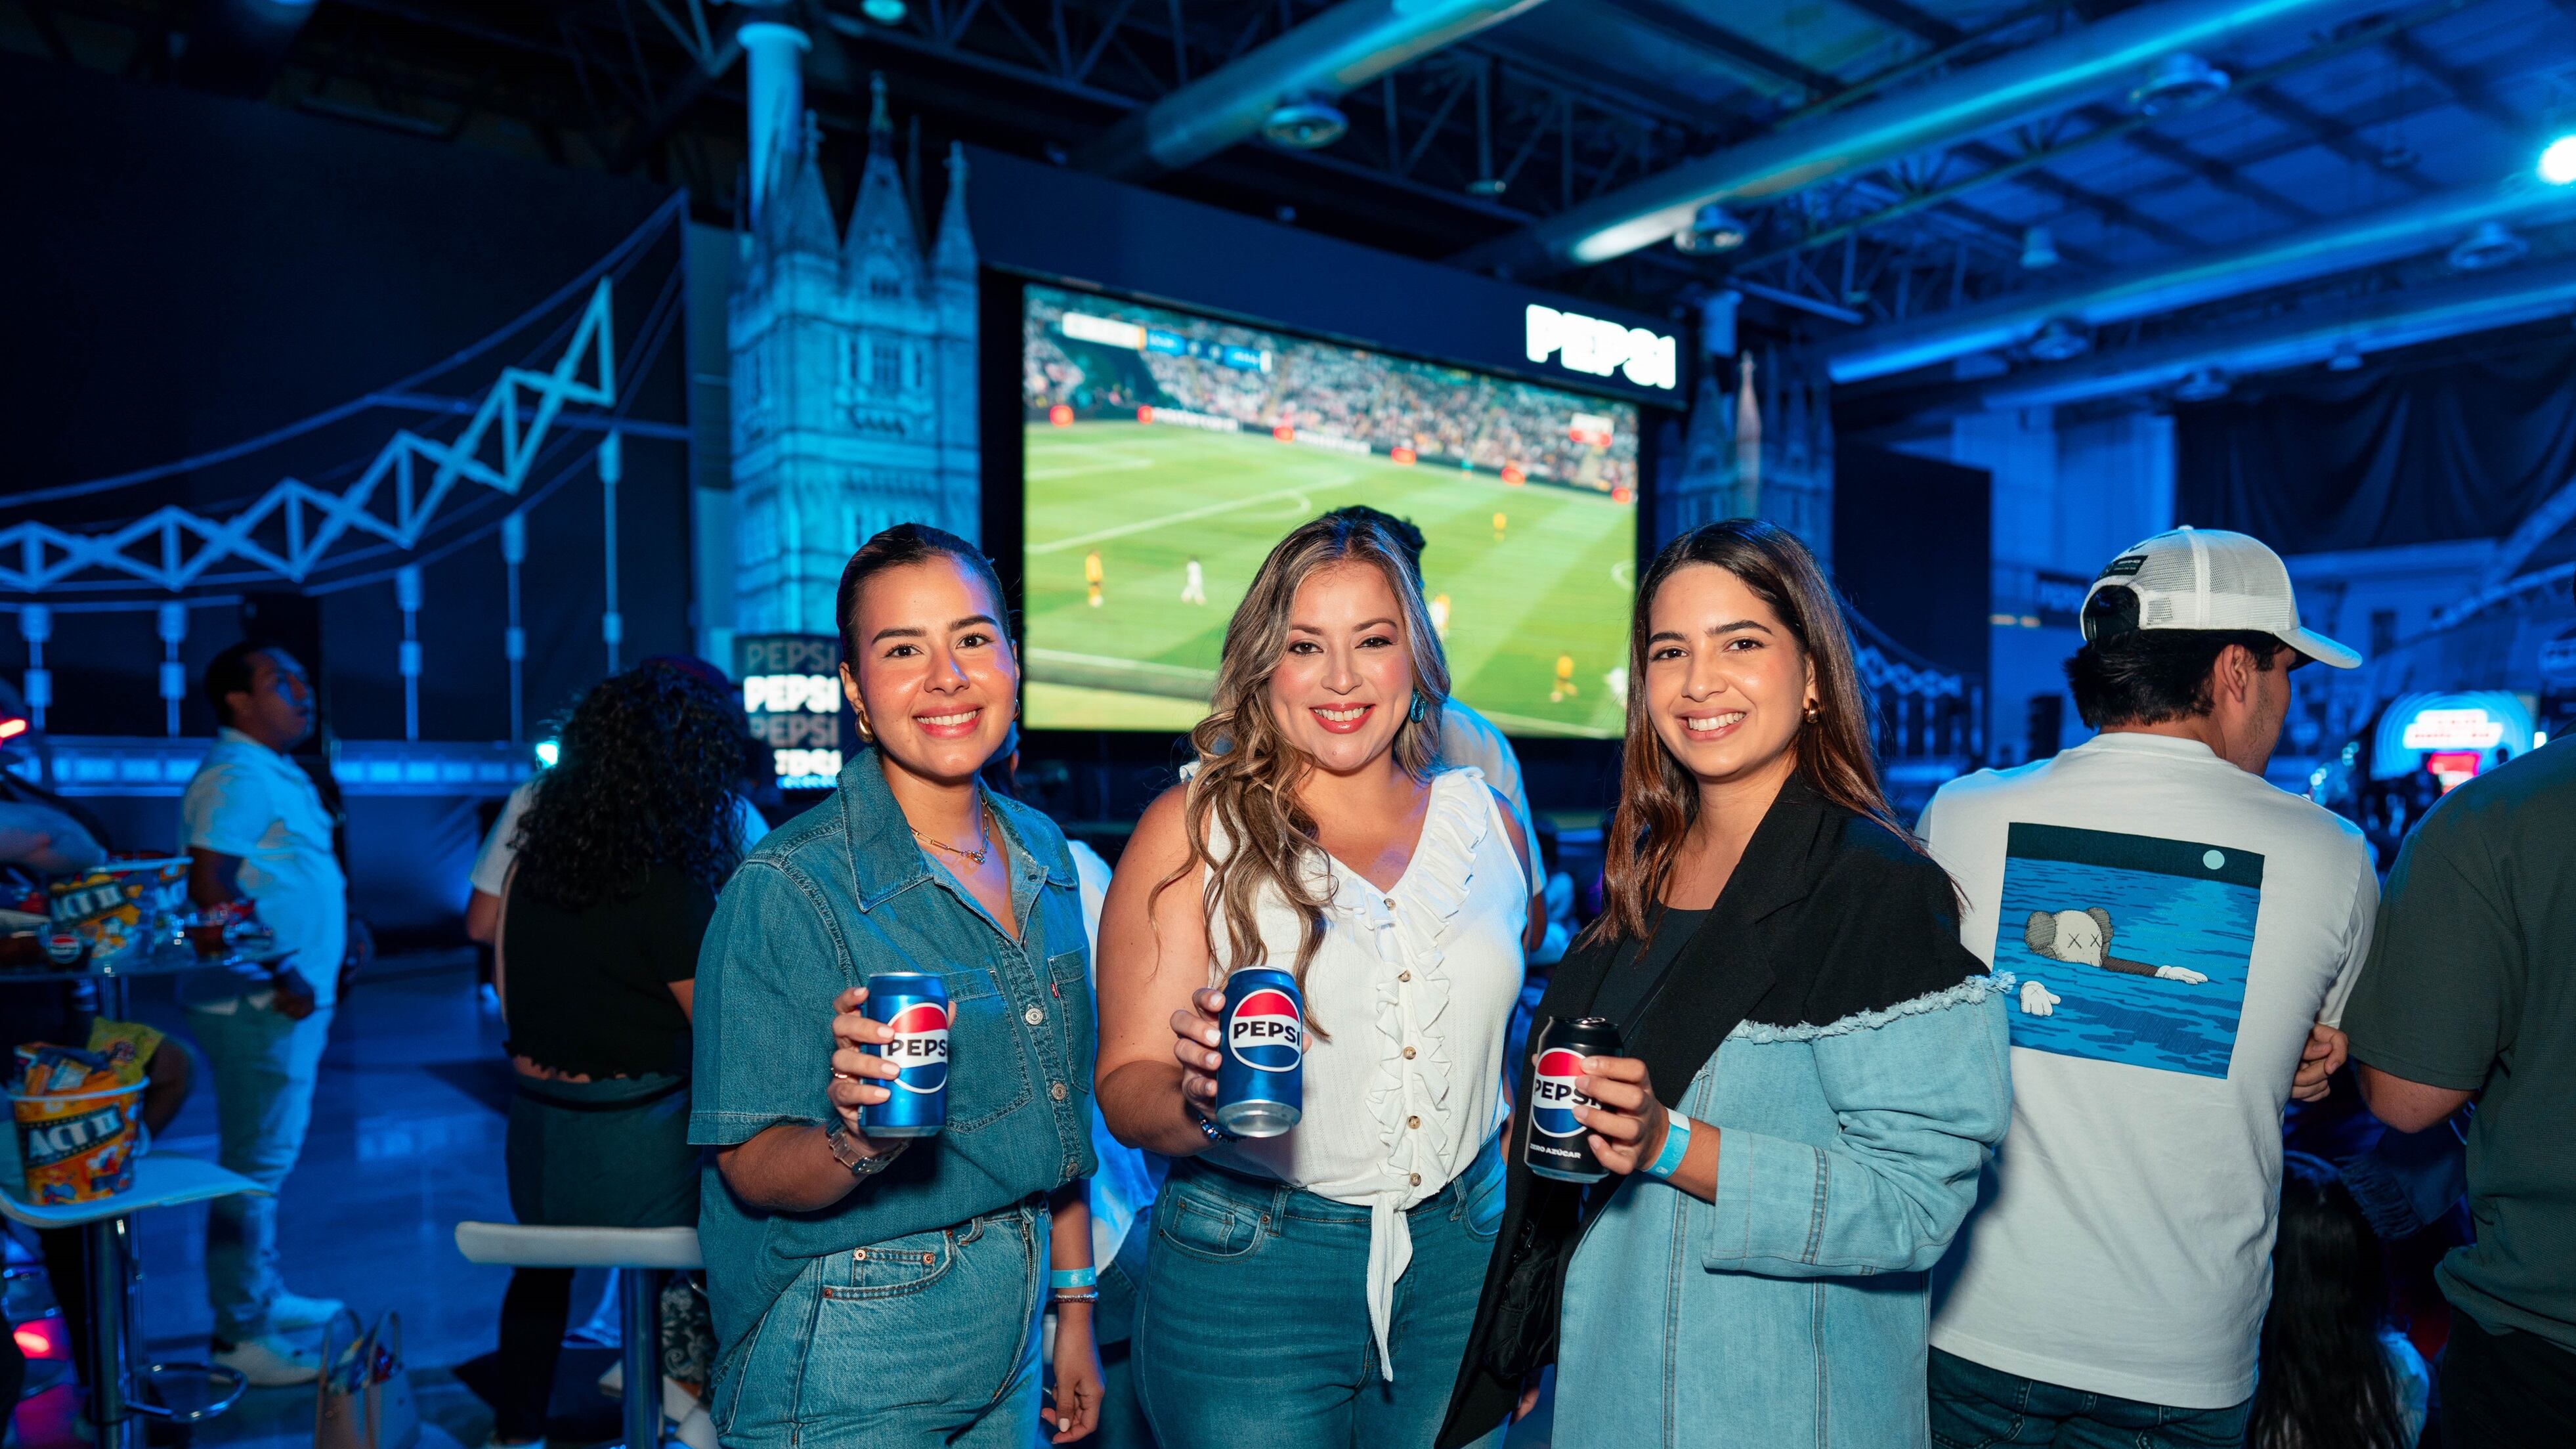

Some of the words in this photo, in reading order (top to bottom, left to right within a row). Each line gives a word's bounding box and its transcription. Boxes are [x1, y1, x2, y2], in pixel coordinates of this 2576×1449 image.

[1526, 304, 1676, 390] PEPSI
[746, 641, 836, 672] PEPSI
[743, 674, 842, 713] PEPSI
[888, 1039, 947, 1057] PEPS
[1234, 1021, 1300, 1047] PEPSI
[29, 1121, 88, 1159] ACT
